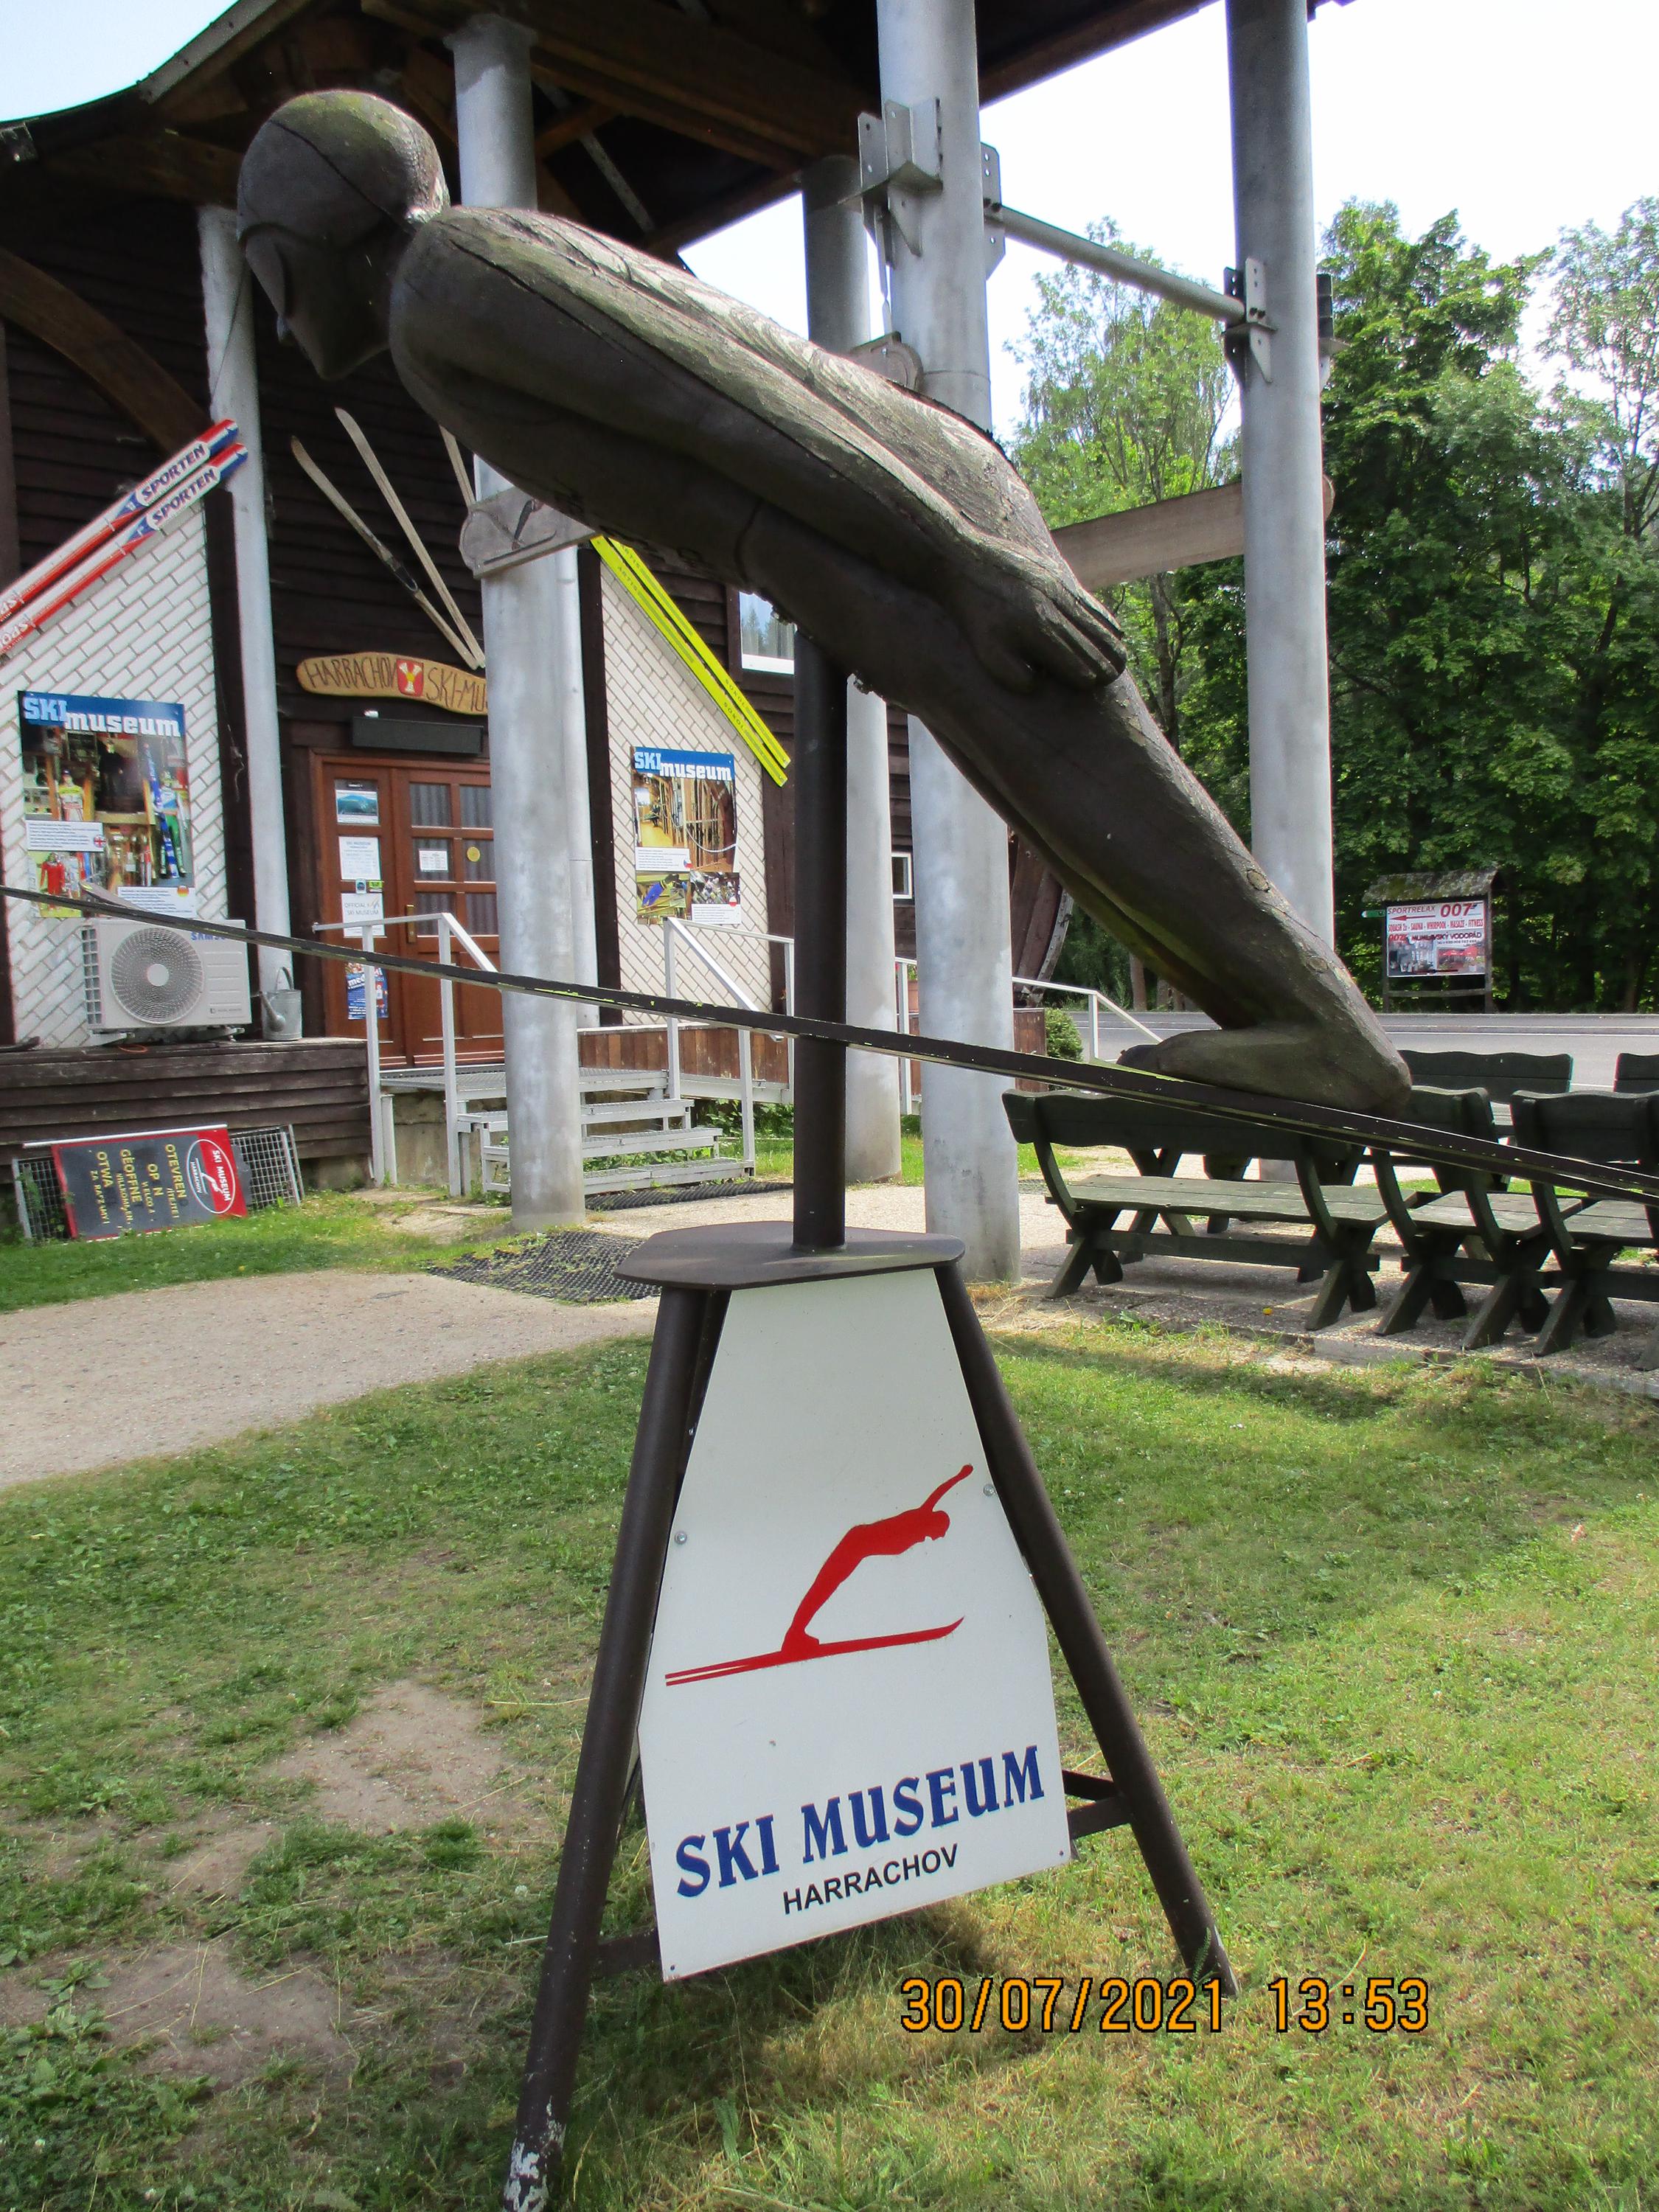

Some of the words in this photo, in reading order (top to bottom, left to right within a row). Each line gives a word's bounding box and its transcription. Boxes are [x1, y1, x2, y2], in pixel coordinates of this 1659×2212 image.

[140, 444, 206, 501] SPORTEN
[152, 469, 218, 526] SPORTEN
[425, 667, 487, 712] SKI-MU
[23, 696, 69, 723] SKI
[64, 712, 181, 737] museum
[634, 751, 662, 771] SKI
[660, 762, 732, 782] museum
[1387, 905, 1436, 915] SPORTRELAX
[1440, 902, 1472, 918] 007
[212, 1150, 223, 1164] SKI
[216, 1166, 232, 1202] MUSEUM
[675, 1813, 781, 1898] SKI
[801, 1745, 1046, 1864] MUSEUM
[782, 1843, 959, 1915] HARRACHOV
